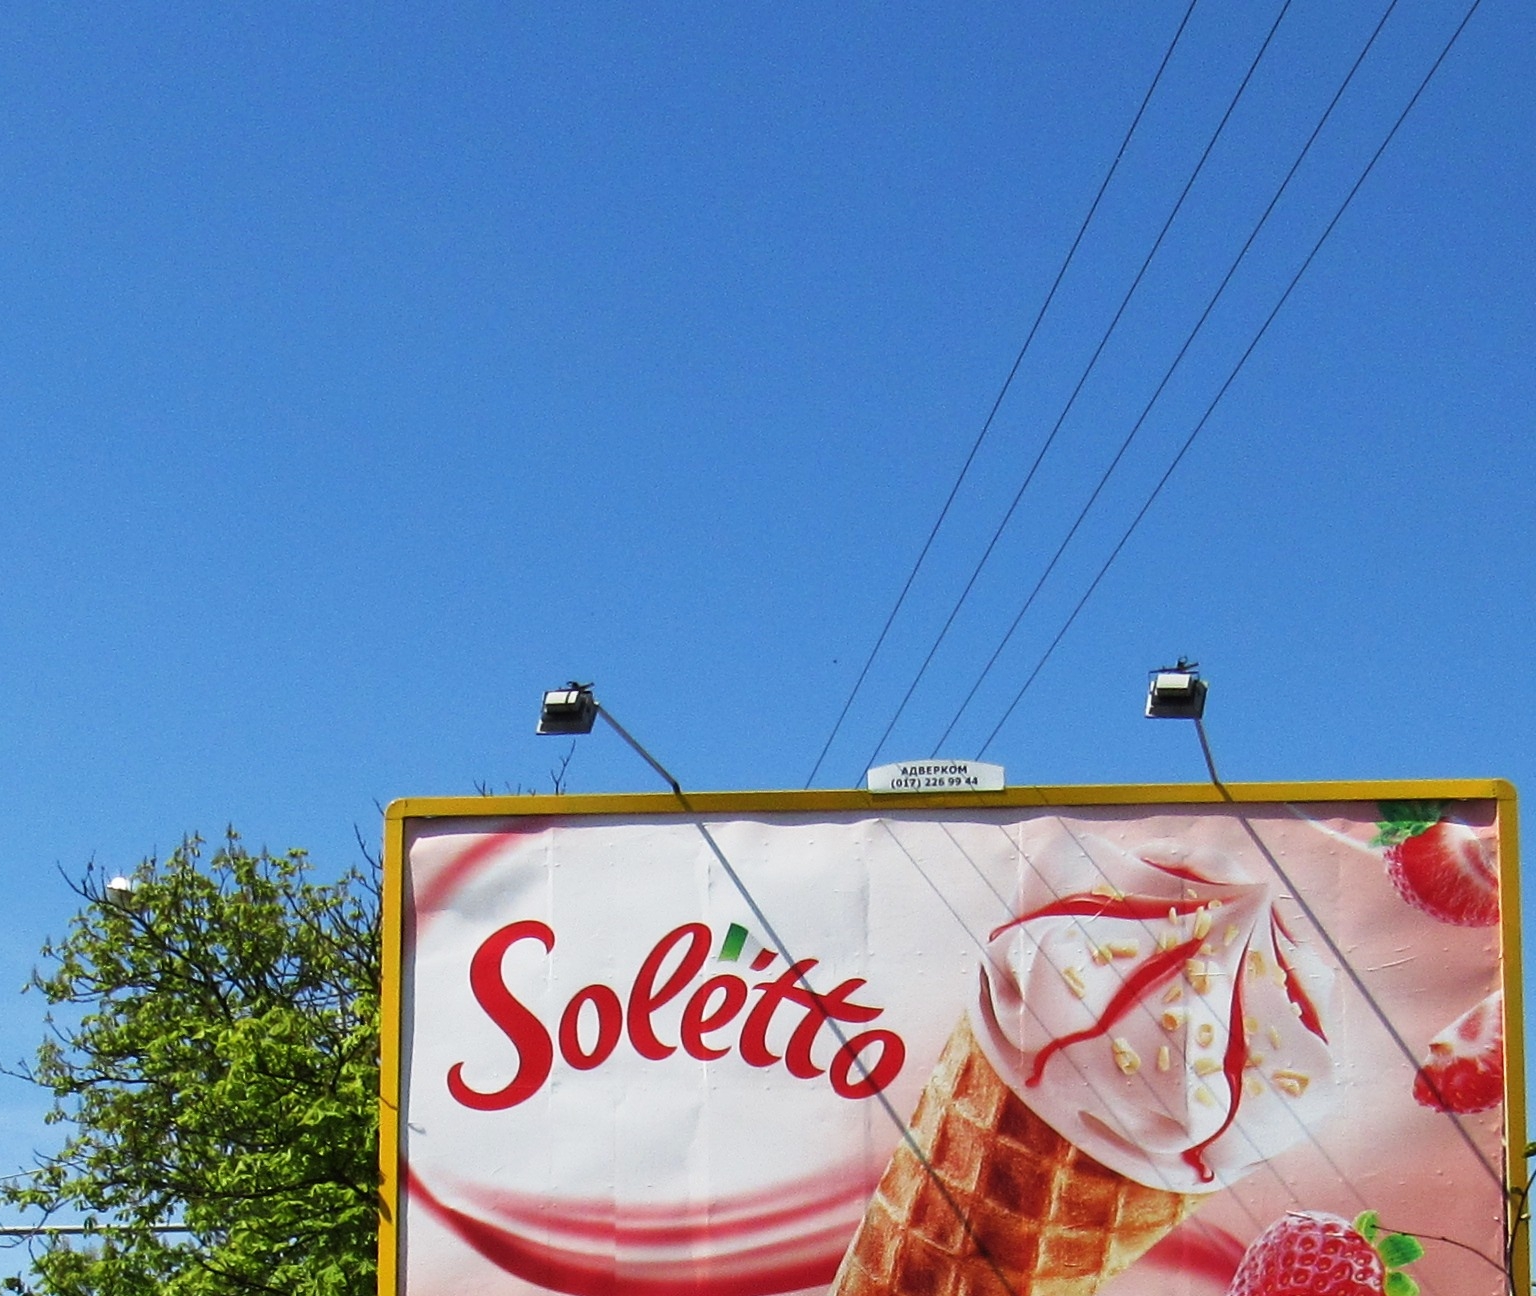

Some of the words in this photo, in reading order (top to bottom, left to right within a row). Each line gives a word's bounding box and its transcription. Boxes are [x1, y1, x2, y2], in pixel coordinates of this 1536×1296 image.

[901, 766, 968, 776] АДВЕРКОМ
[891, 778, 921, 789] (017)
[925, 778, 945, 787] 226
[948, 777, 962, 786] 99
[965, 777, 978, 785] 44
